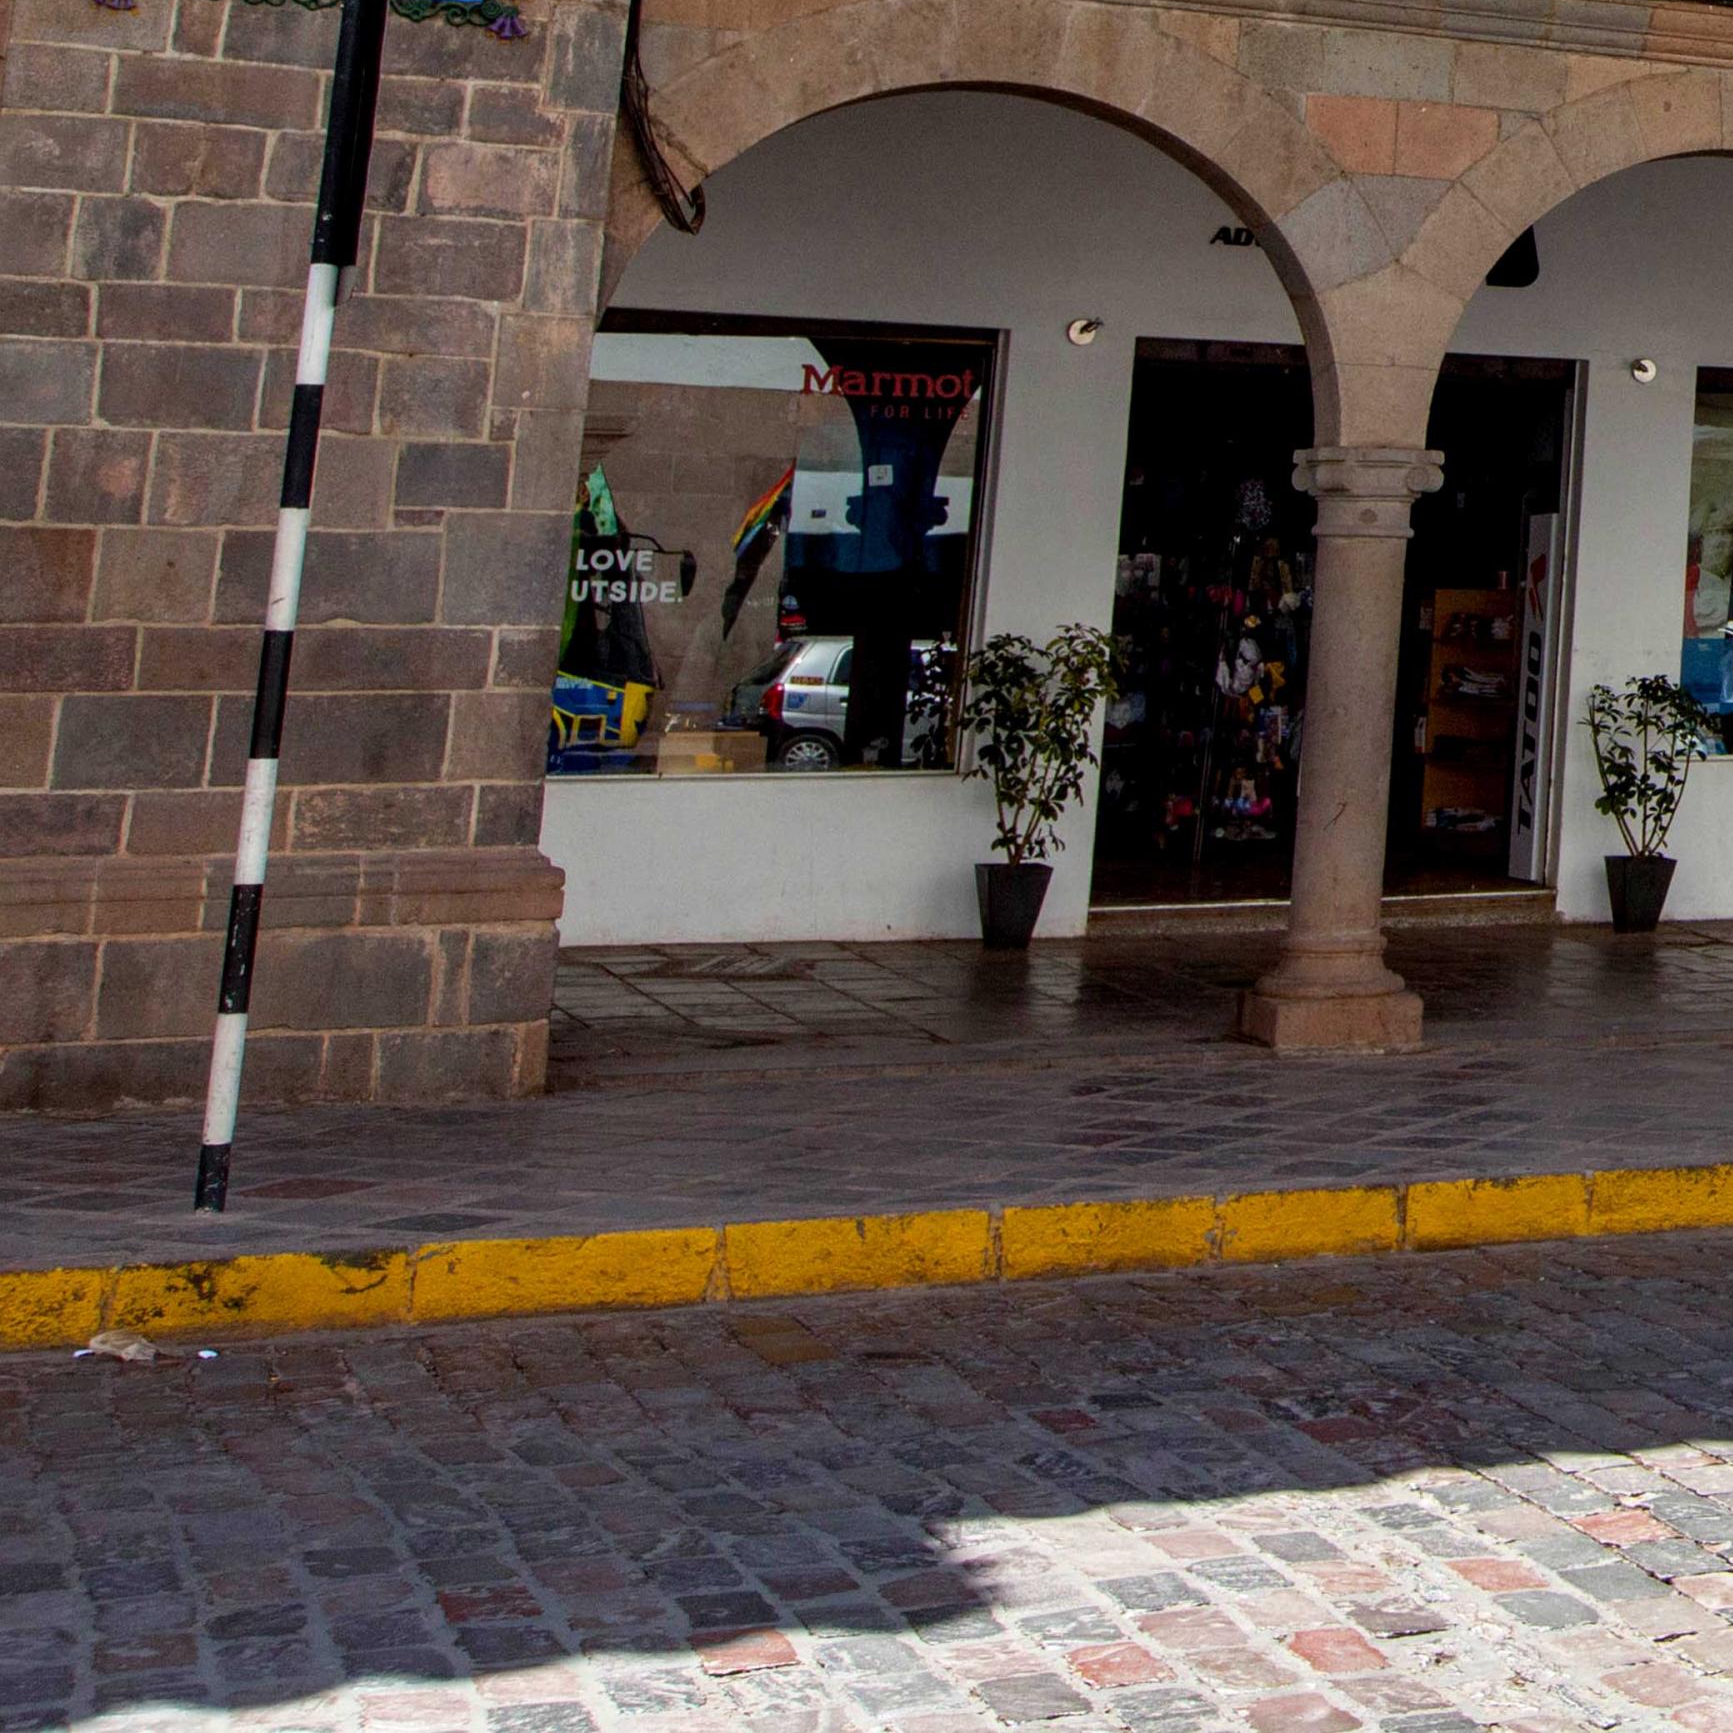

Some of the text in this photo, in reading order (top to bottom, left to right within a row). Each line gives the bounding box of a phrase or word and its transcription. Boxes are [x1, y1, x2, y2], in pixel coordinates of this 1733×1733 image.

[802, 363, 975, 400] Marmot
[870, 404, 971, 421] FOR LIFE
[576, 548, 654, 572] LOVE
[570, 579, 684, 604] UTSIDE.
[1517, 630, 1543, 835] TATOO
